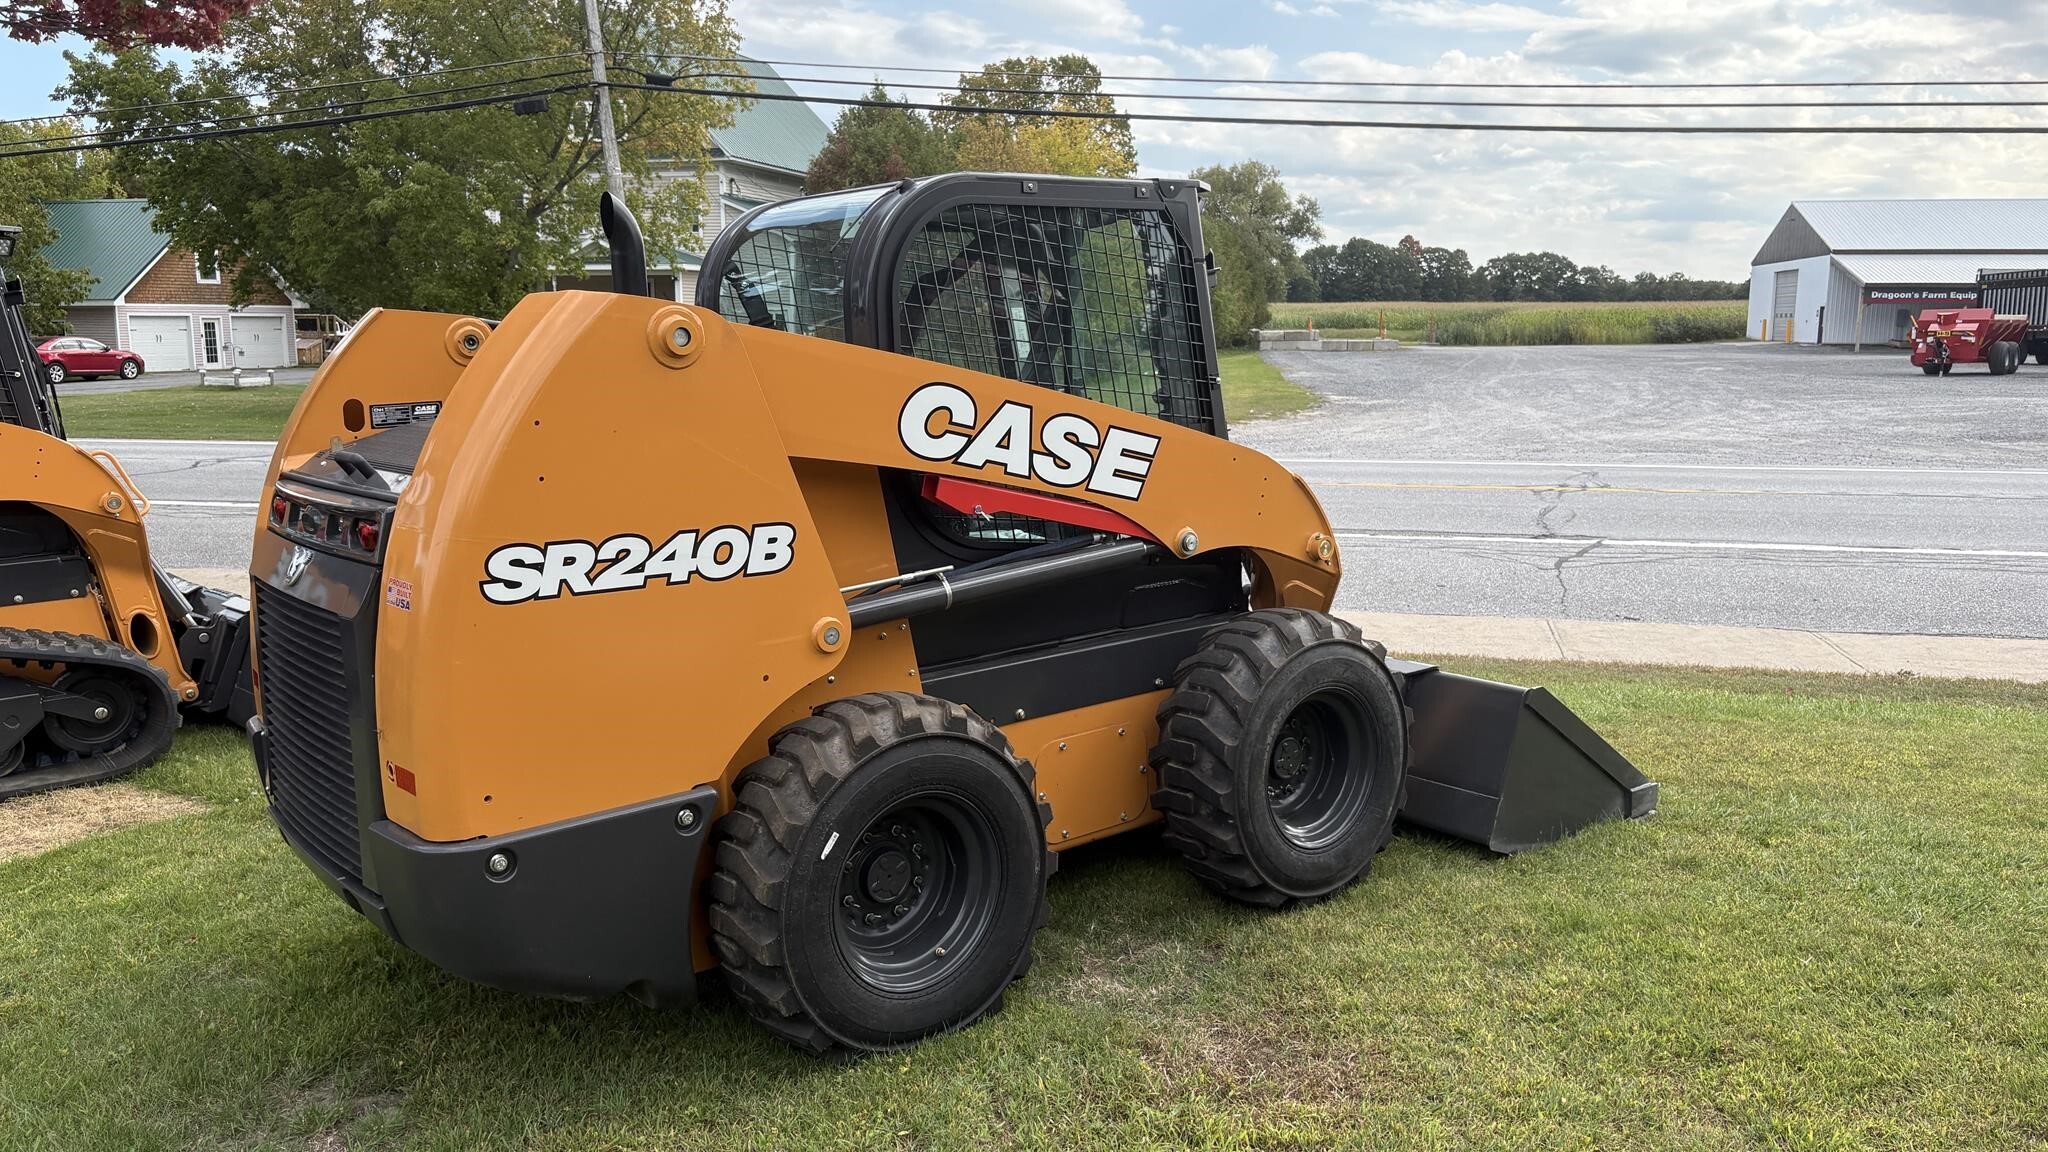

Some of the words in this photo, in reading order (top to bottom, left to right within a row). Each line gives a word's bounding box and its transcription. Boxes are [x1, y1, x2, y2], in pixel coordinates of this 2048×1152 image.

[1871, 291, 1919, 299] Dragoon's
[1922, 291, 1947, 299] Farm
[1950, 291, 1977, 300] Equip
[898, 382, 1161, 502] CASE
[479, 521, 796, 605] SR240B
[389, 578, 412, 590] PROUDLY
[397, 588, 411, 598] BUILT
[396, 598, 410, 610] USA
